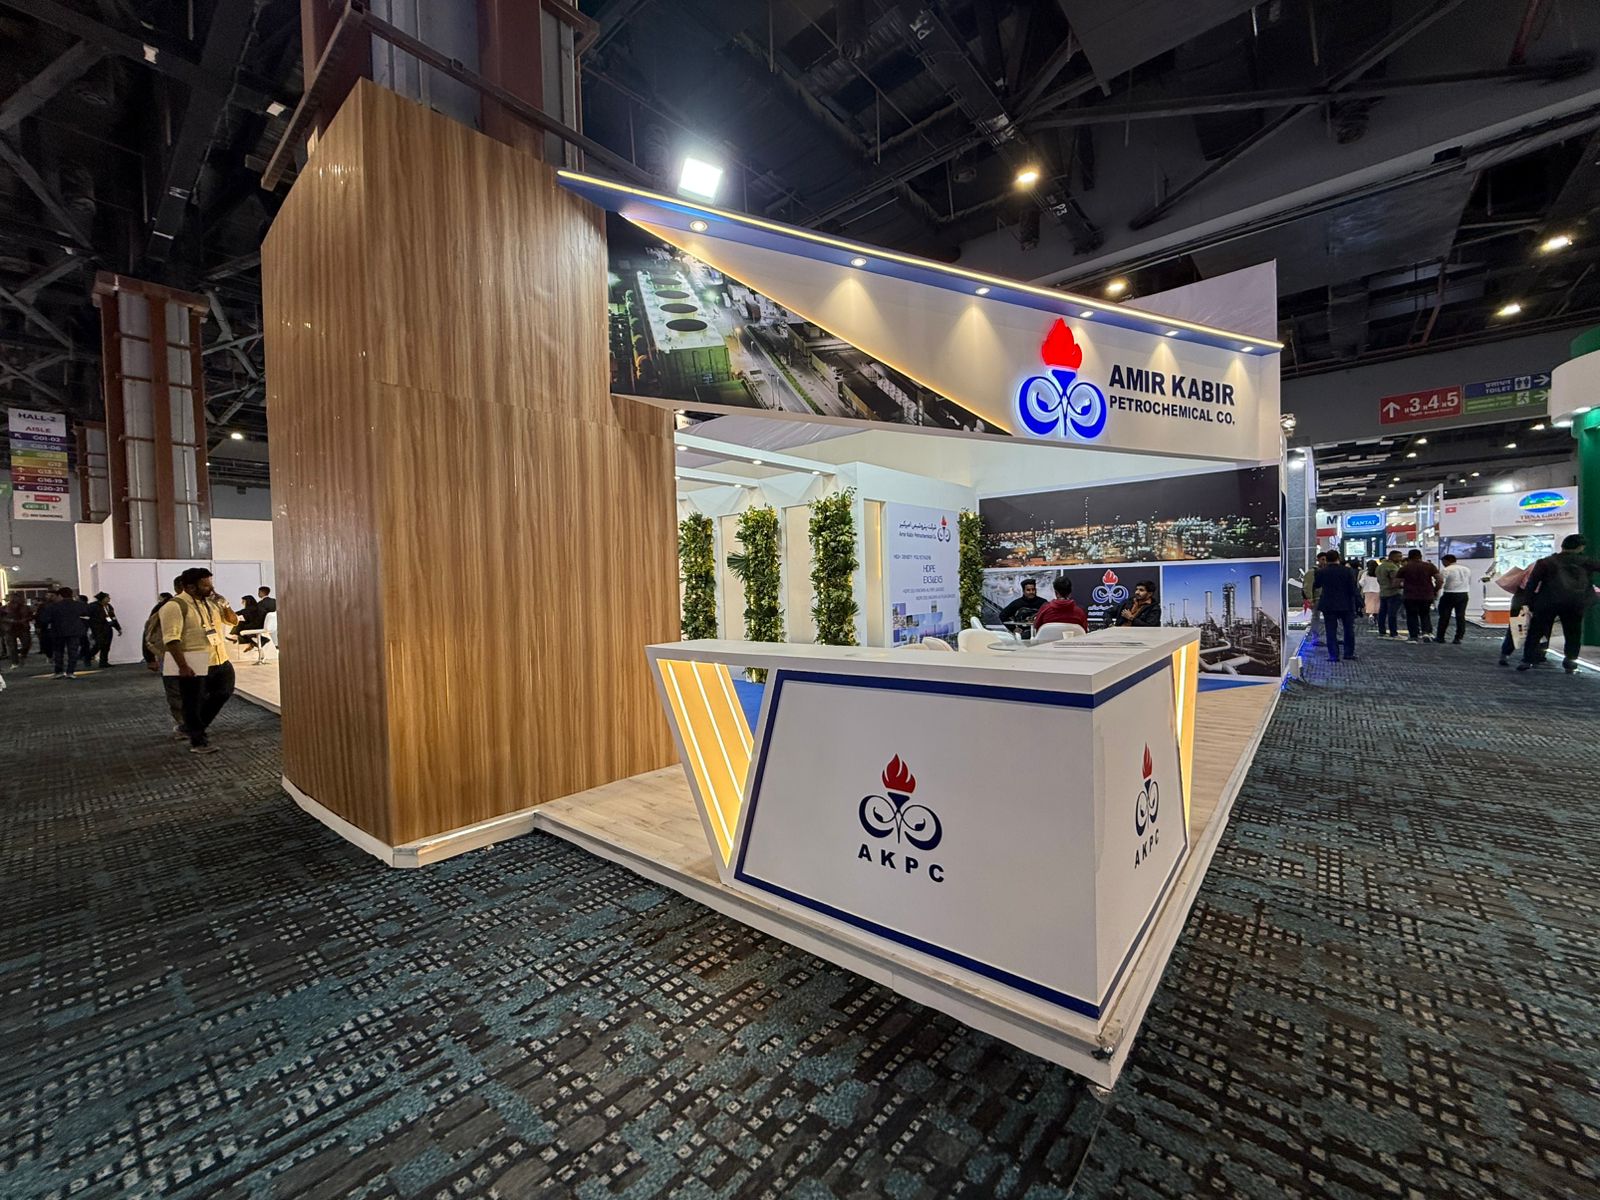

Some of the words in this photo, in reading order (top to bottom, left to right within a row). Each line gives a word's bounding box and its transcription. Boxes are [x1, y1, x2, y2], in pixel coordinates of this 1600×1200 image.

[1109, 364, 1166, 396] AMIR
[1172, 374, 1235, 406] KABIR
[1486, 385, 1511, 394] TOILET
[18, 412, 57, 423] HALL-2
[1109, 395, 1213, 422] PETROCHEMICAL
[1216, 411, 1236, 426] CO.
[858, 843, 945, 883] AKPC
[1134, 828, 1160, 869] AKPC
